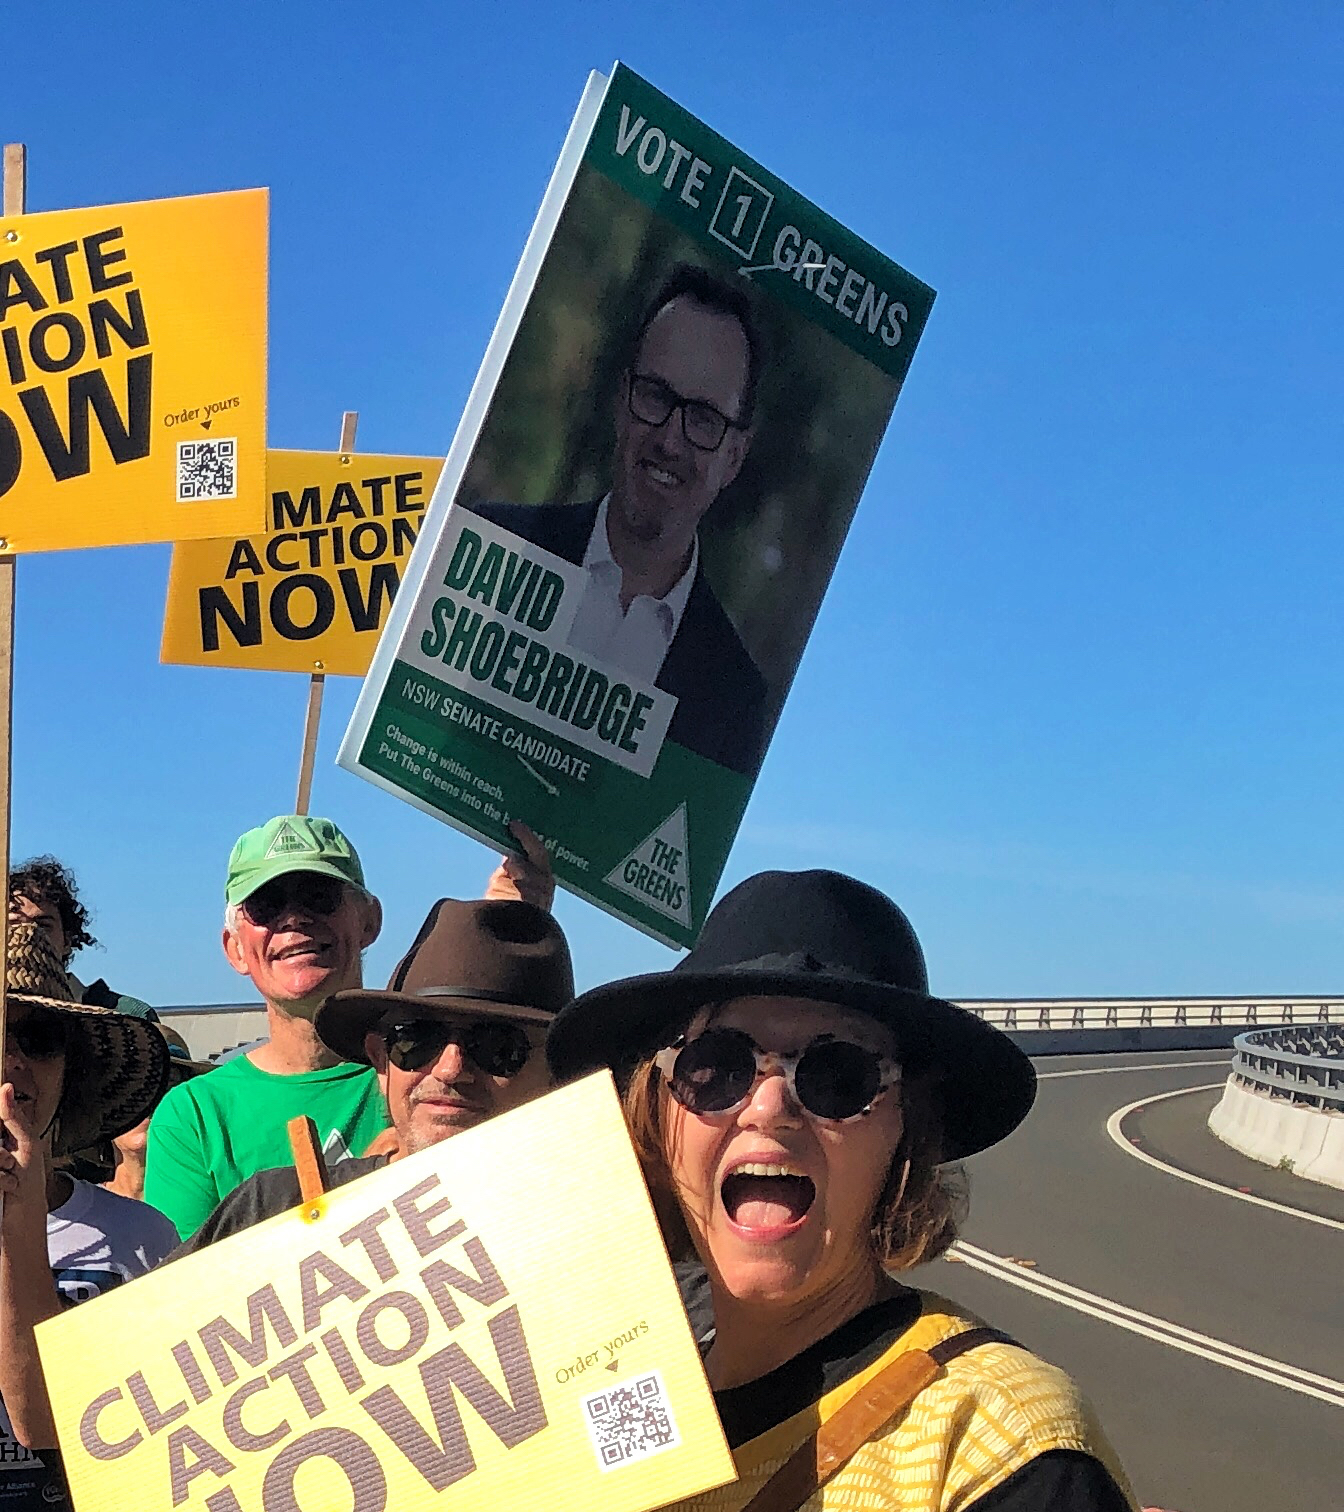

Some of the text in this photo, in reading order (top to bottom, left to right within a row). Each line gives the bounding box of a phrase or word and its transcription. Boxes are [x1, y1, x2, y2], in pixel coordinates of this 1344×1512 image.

[616, 104, 909, 347] VOTE 1 GREENS
[164, 395, 240, 428] Order yours
[272, 472, 425, 530] MATE
[225, 515, 422, 580] ACTION
[443, 528, 564, 632] DAVID
[420, 597, 655, 754] SHOEBRIDGE
[386, 724, 427, 755] Change
[427, 746, 439, 762] is
[439, 756, 472, 782] within
[401, 678, 591, 782] NSW SENATE CANDIDATE
[378, 741, 399, 762] Put
[400, 753, 421, 775] The
[422, 767, 460, 797] Greens
[483, 803, 501, 821] the
[544, 837, 590, 872] of power.
[623, 858, 685, 910] GREENS
[650, 837, 683, 875] THE
[79, 1172, 469, 1462] CLIMATE
[168, 1235, 511, 1508] ACTION
[555, 1320, 649, 1384] Order yours
